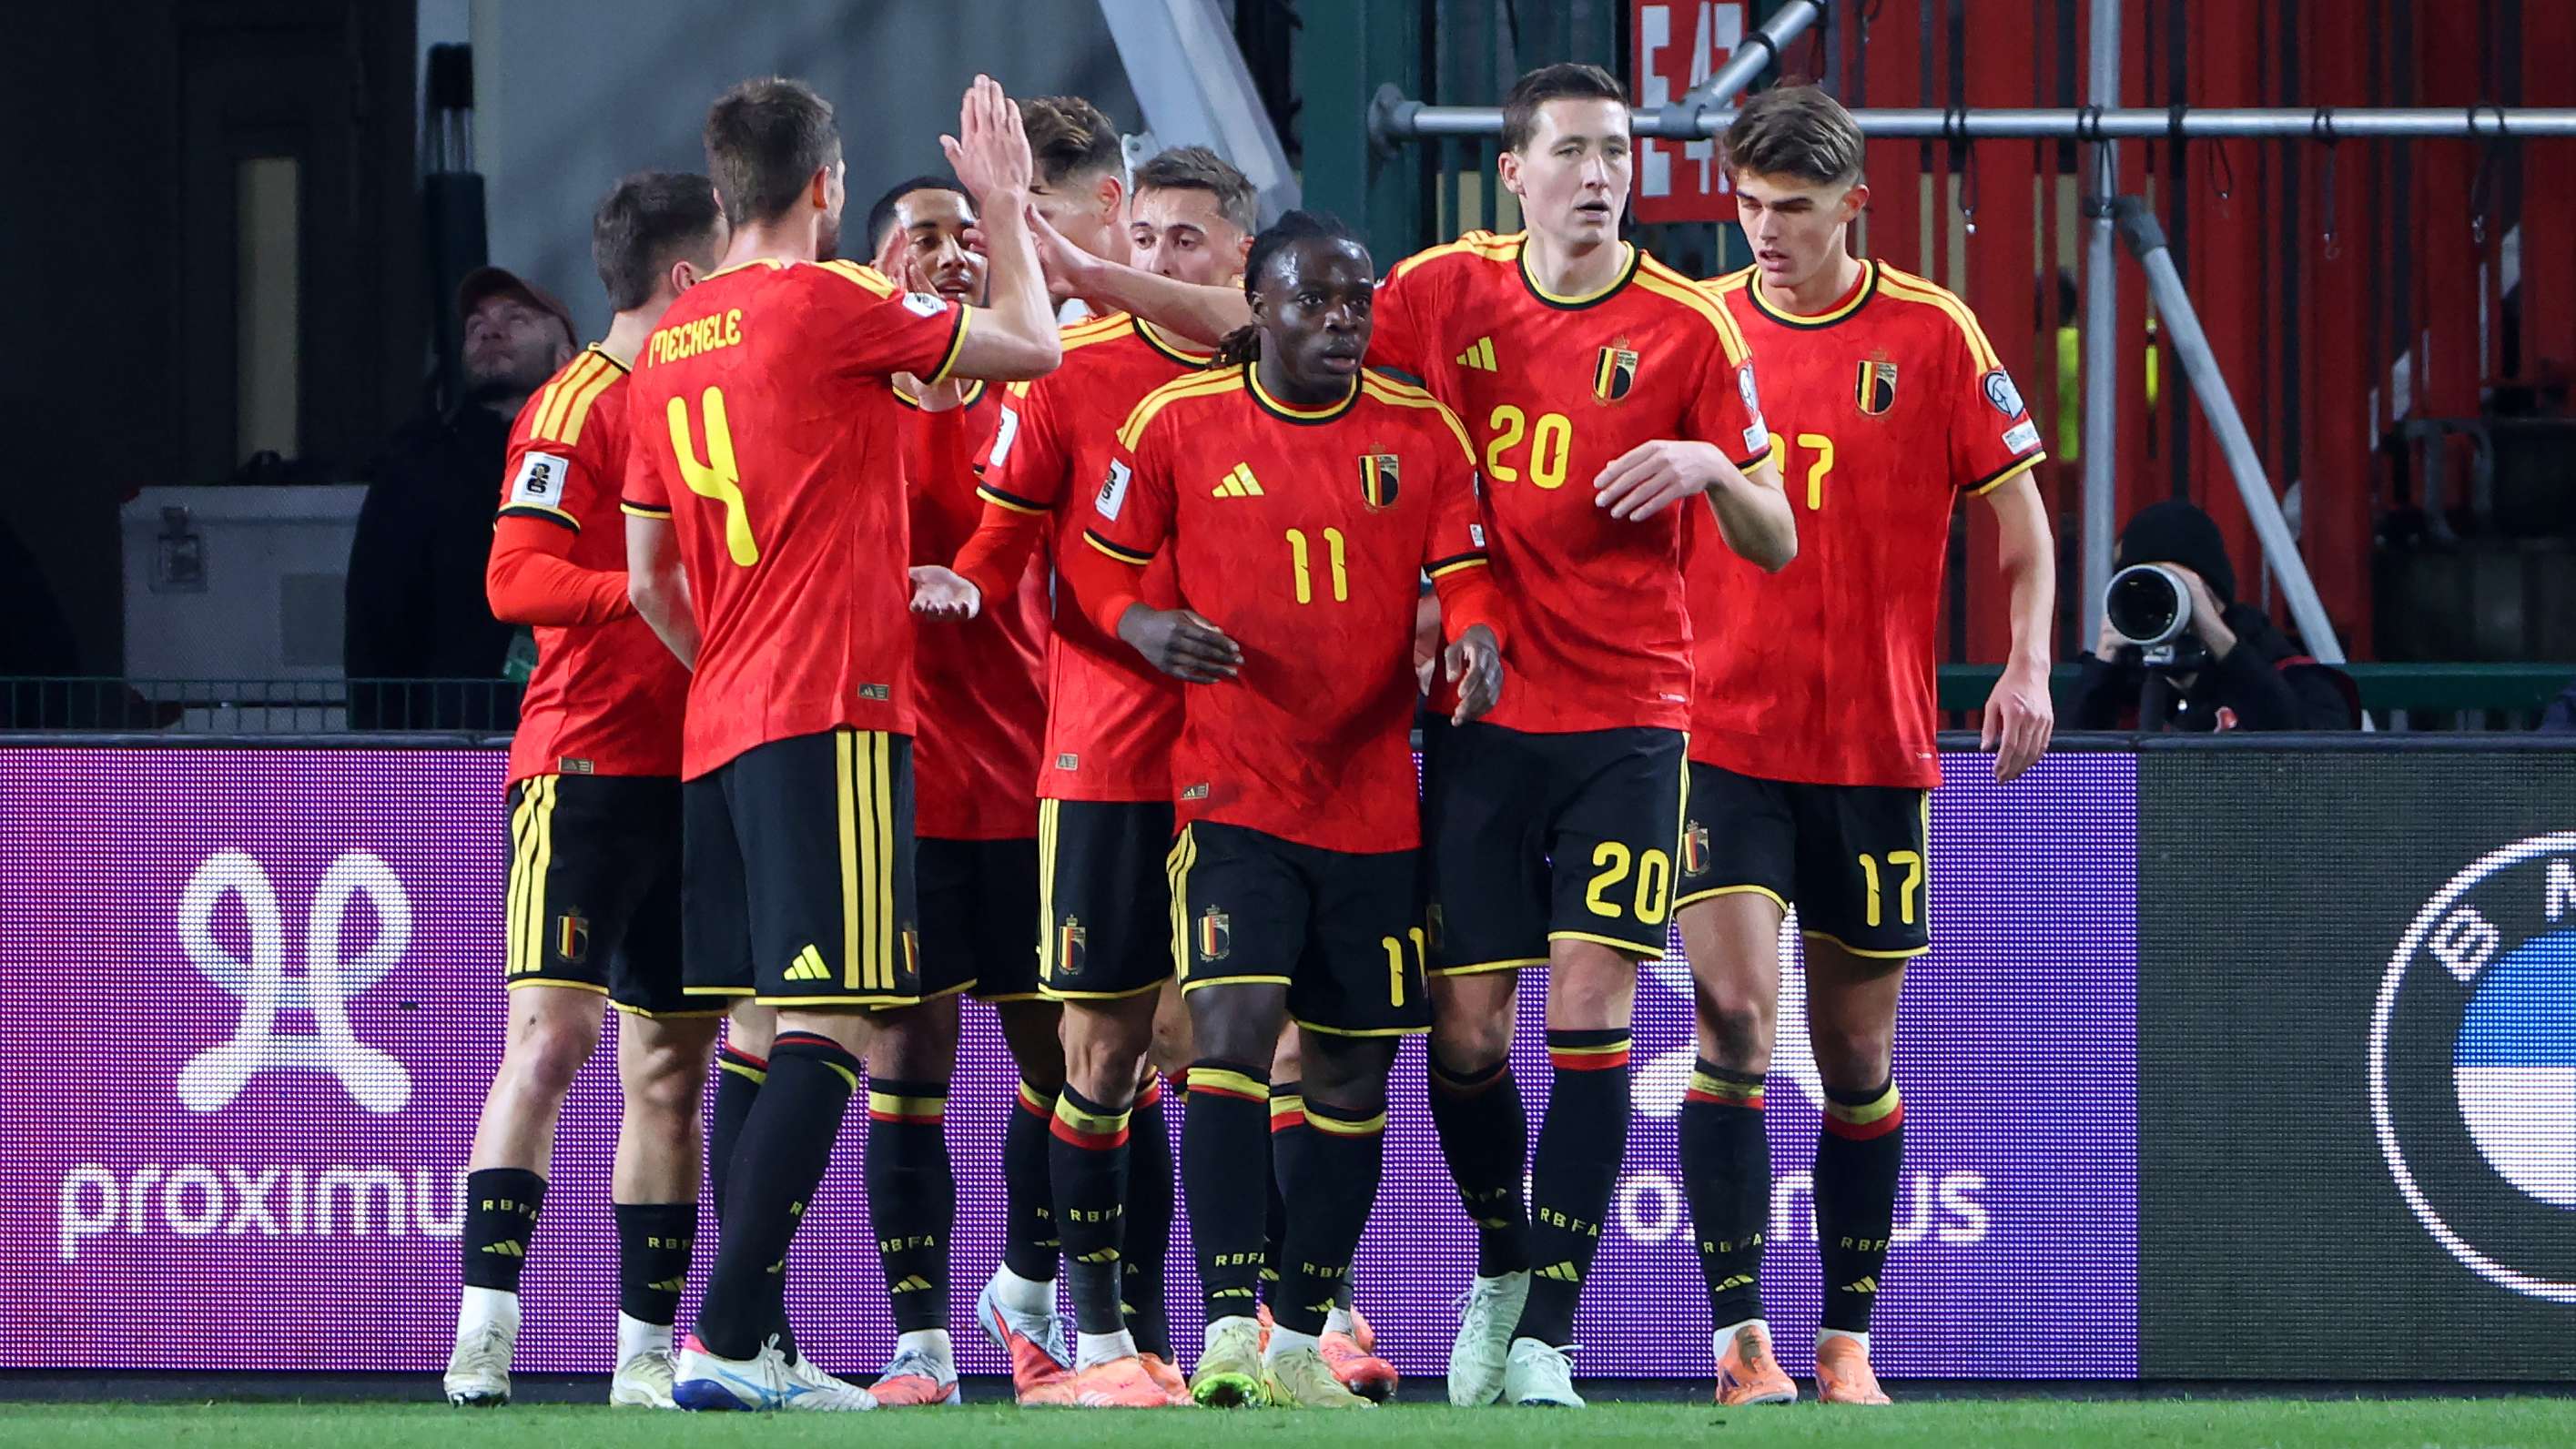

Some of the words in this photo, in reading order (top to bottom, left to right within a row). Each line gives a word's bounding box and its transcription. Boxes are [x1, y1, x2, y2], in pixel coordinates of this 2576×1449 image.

[647, 308, 742, 369] MECHELE
[666, 385, 759, 566] 4
[1486, 403, 1572, 489] 20
[1285, 526, 1348, 604] 11
[1586, 841, 1669, 925] 20
[1858, 849, 1922, 927] 17
[58, 1162, 469, 1262] proximu
[879, 1234, 935, 1253] RBFA
[1540, 1207, 1598, 1238] RBFA
